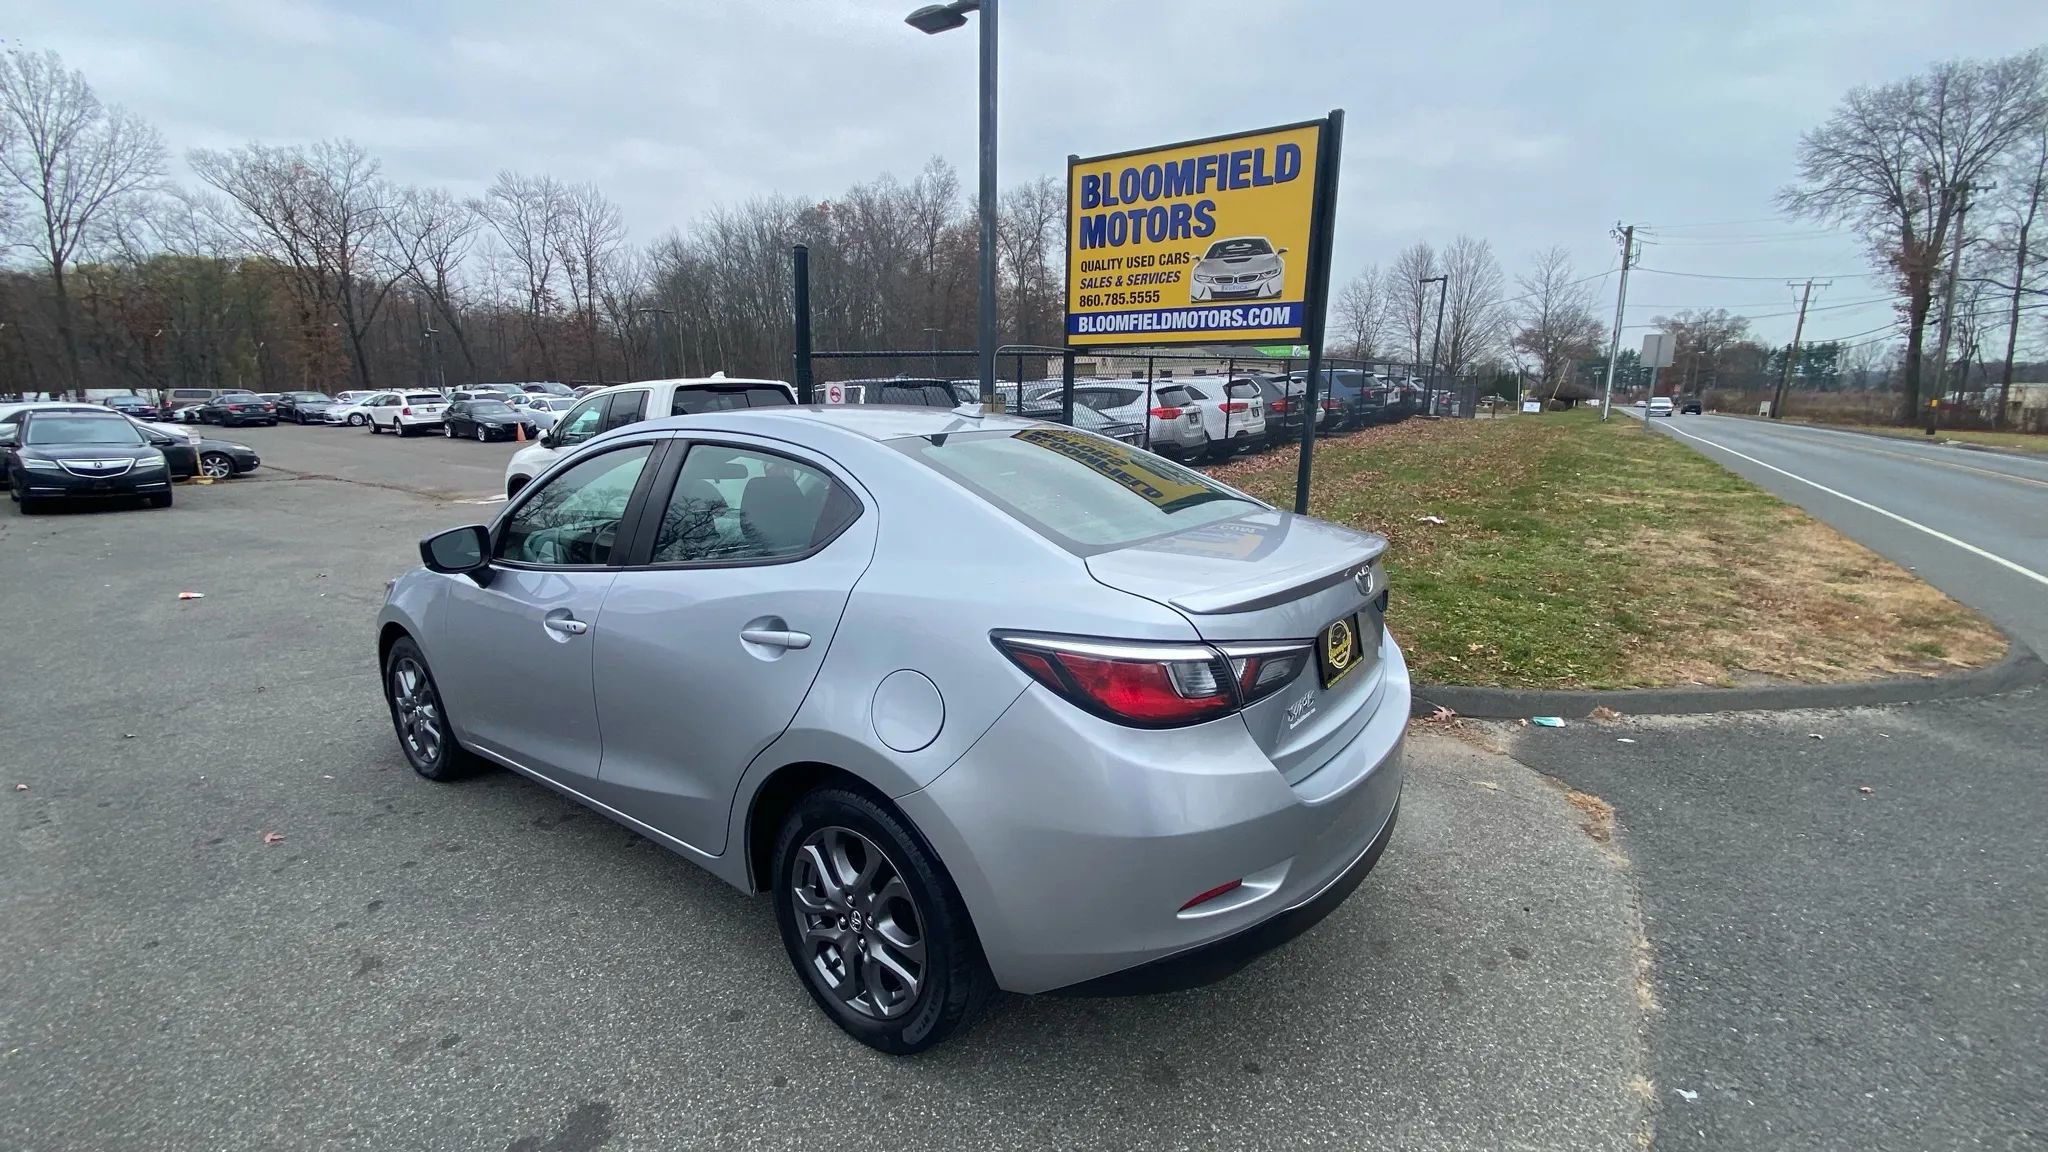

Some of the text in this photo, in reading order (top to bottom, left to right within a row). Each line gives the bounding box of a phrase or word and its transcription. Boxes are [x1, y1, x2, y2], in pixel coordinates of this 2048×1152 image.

[1081, 143, 1301, 209] BLOOMFIELD
[1079, 200, 1216, 250] MOTORS
[1080, 252, 1190, 273] QUALITY USED CARS
[1080, 271, 1181, 290] SALES & SERVICES
[1079, 290, 1160, 307] 860.785.5555
[1078, 307, 1290, 333] BLOOMFIELDMOTORS.COM
